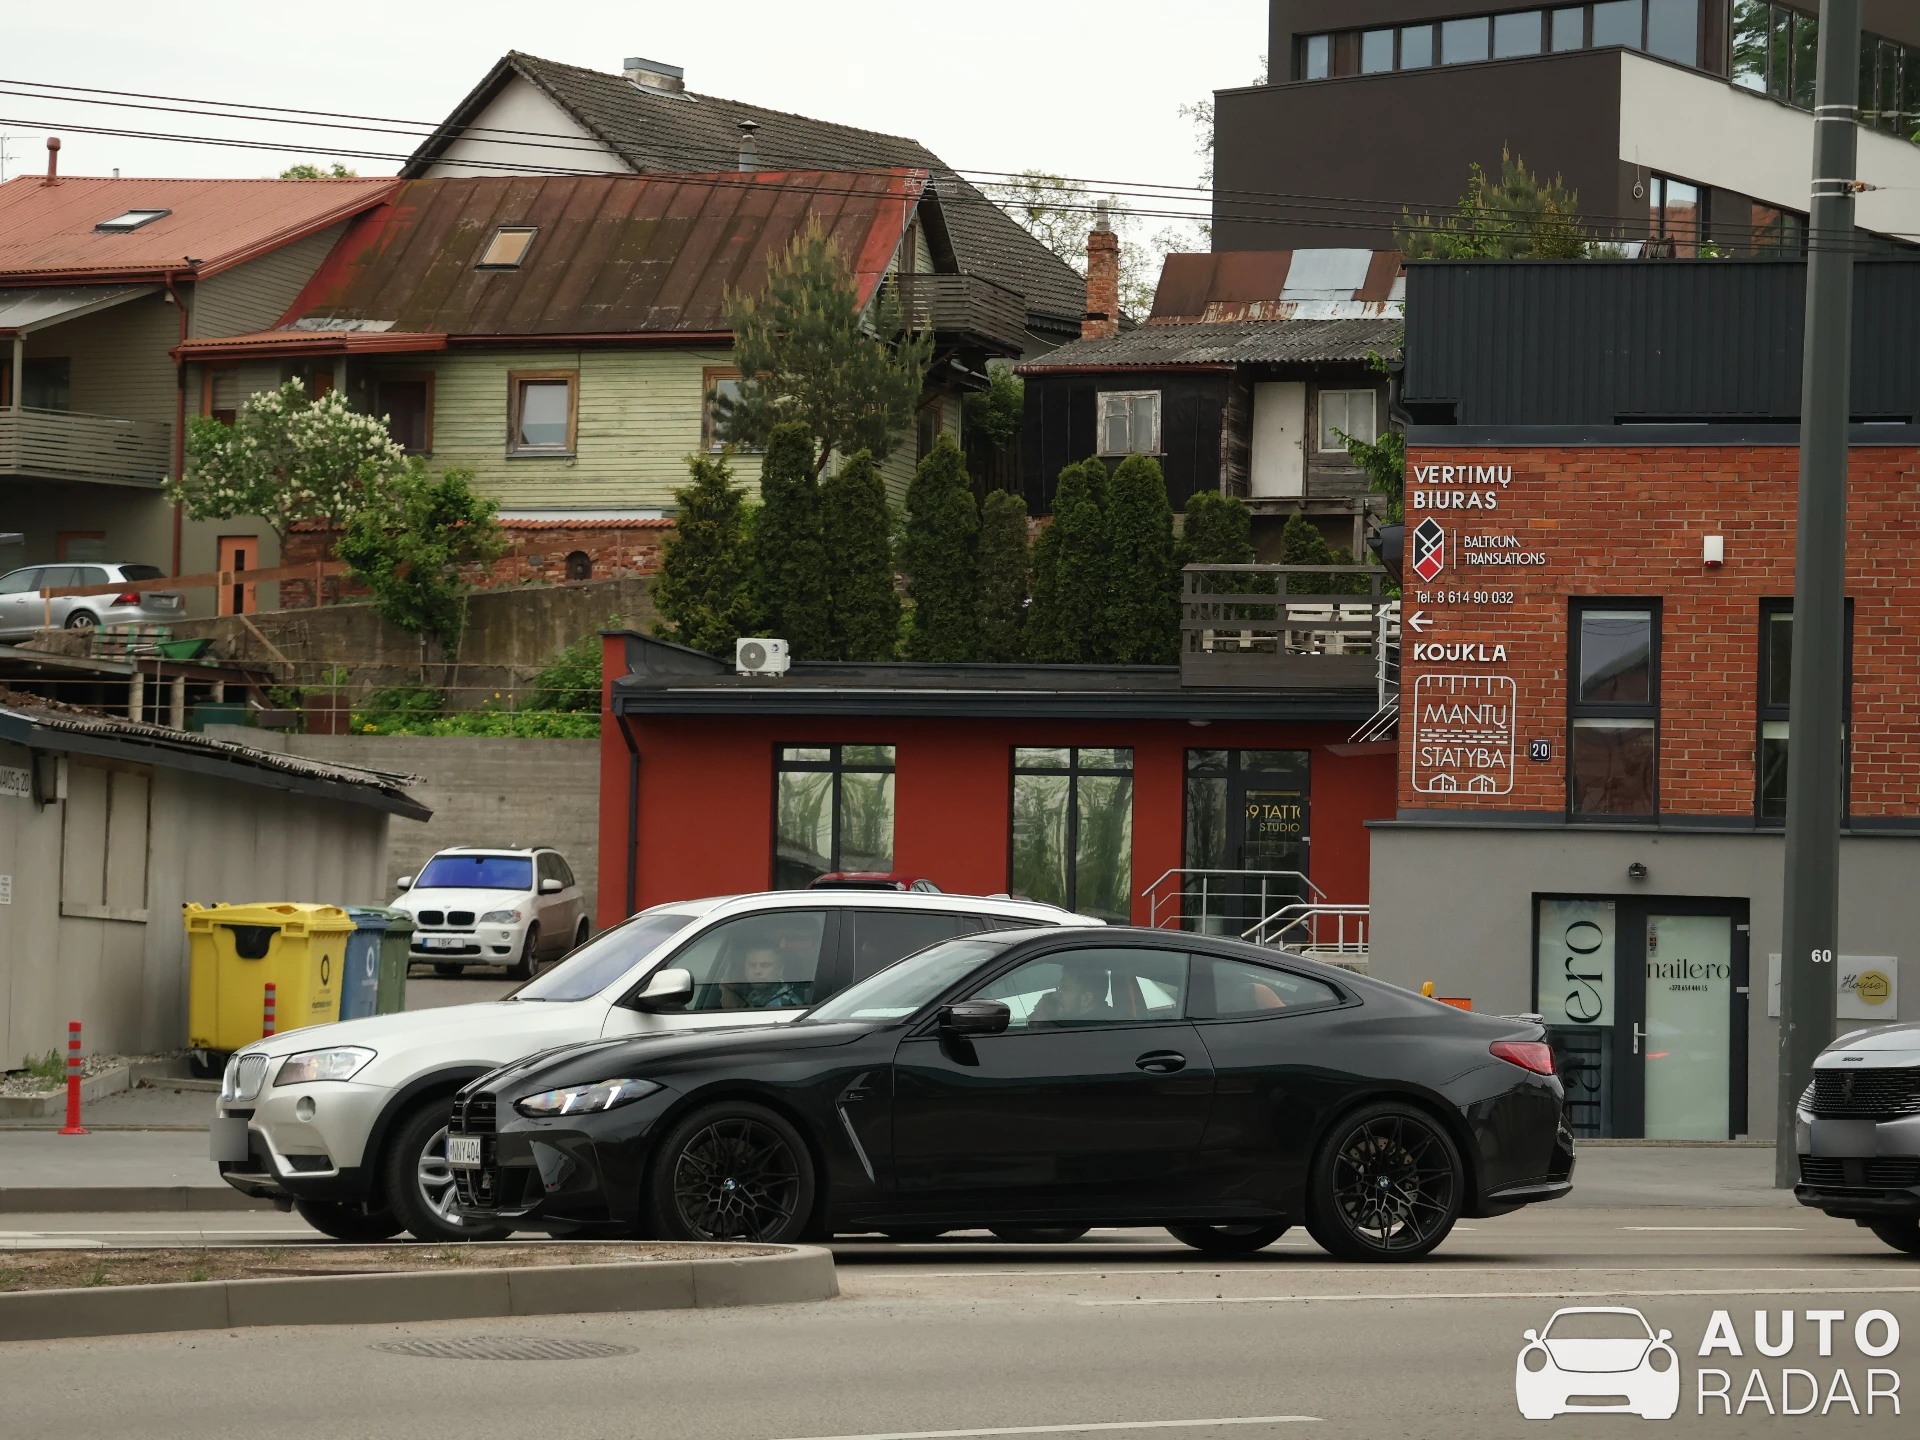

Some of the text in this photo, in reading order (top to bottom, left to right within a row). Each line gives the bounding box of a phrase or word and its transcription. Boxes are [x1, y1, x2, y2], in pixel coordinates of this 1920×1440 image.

[1413, 466, 1512, 488] VERTIMŲ
[1413, 490, 1498, 510] BIURAS
[1464, 535, 1522, 549] BALTICUM
[1464, 552, 1546, 566] TRANSLATIONS
[1415, 590, 1514, 605] Tel. 8 614 90 032
[1420, 746, 1506, 768] STATYBA
[1532, 743, 1548, 757] 20
[21, 772, 30, 792] 20
[1262, 805, 1300, 819] TATT
[1260, 822, 1300, 833] STUDIO
[1811, 949, 1832, 963] 60
[1647, 958, 1731, 979] nailero
[1841, 974, 1884, 990] House
